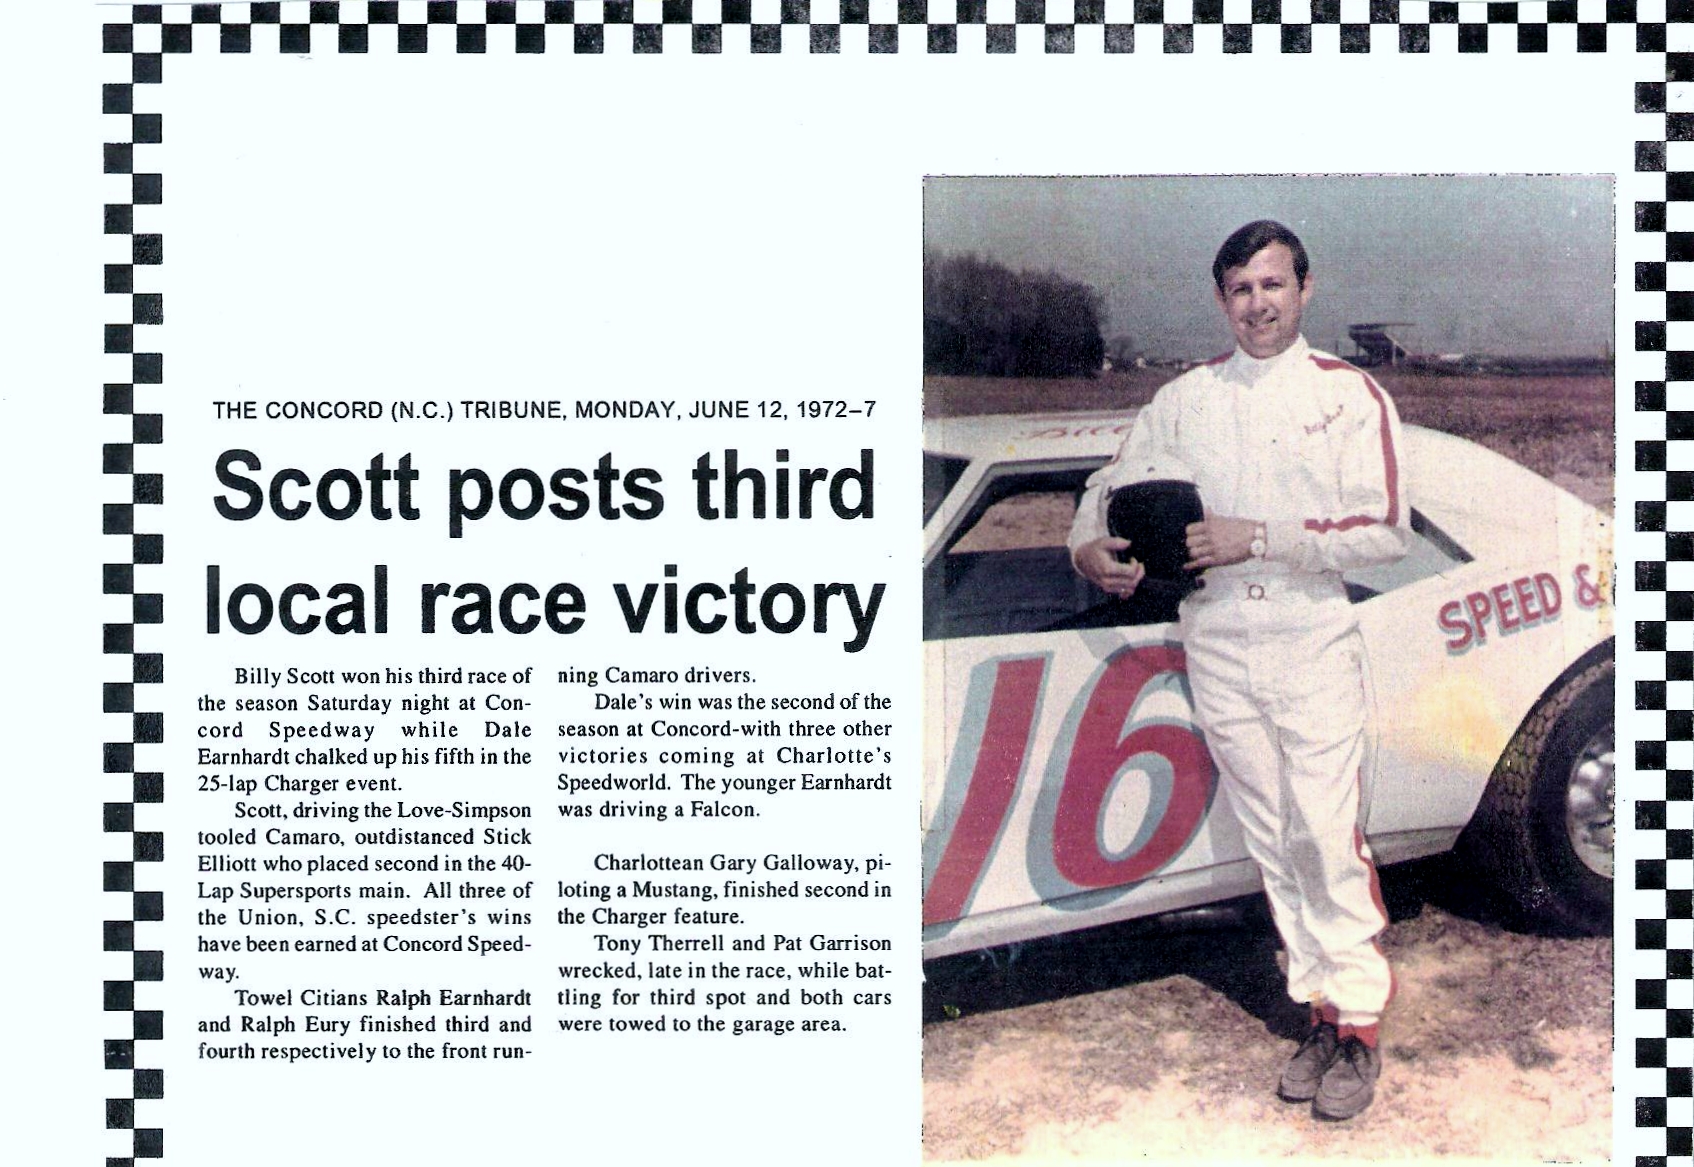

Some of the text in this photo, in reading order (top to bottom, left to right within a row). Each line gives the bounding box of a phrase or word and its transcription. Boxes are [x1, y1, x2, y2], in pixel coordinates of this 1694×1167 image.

[213, 402, 257, 419] THE
[266, 401, 382, 418] CONCORD
[392, 401, 453, 422] (N.C.)
[461, 401, 566, 420] TRIBUNE,
[576, 401, 680, 420] MONDAY,
[689, 401, 749, 418] JUNE
[758, 401, 787, 420] 12,
[214, 449, 873, 538] Scott posts third
[207, 564, 886, 653] local race victory
[1439, 563, 1606, 653] SPEED &
[235, 666, 534, 689] Billy Scott won his third race of
[557, 666, 756, 688] ning Camaro drivers.
[197, 693, 532, 716] the season Saturday night at Con-
[594, 692, 892, 711] Dale's win was the second of the
[197, 720, 532, 743] cord Speedway while Dale
[558, 719, 893, 738] season at Concord-with three other
[197, 747, 532, 769] Earnhardt chalked up his fifth in the
[198, 774, 402, 796] 25-lap Charger event.
[557, 772, 892, 795] Speedworld. The younger Earnhardt
[923, 642, 1220, 942] 16
[234, 801, 532, 823] Scott, driving the Love-Simpson
[197, 827, 532, 847] tooled Camaro, outdistanced Stick
[197, 854, 532, 876] Elliott who placed second in the 40-
[593, 853, 892, 875] Charlottean Gary Galloway, pi-
[197, 881, 534, 904] Lap Supersports main. All three of
[557, 880, 892, 903] loting a Mustang, finished second in
[557, 906, 745, 929] the Charger feature.
[197, 934, 532, 957] have been earned at Concord Speed-
[593, 934, 892, 956] Tony Therrell and Pat Garrison
[198, 967, 240, 984] way.
[558, 961, 892, 981] wrecked, late in the race, while bat-
[233, 988, 532, 1011] Towel Citians Ralph Earnhardt
[557, 987, 892, 1010] tling for third spot and both cars
[197, 1014, 532, 1037] and Ralph Eury finished third and
[558, 1014, 847, 1036] were towed to the garage area.
[198, 1041, 532, 1064] fourth respectively to the front run-
